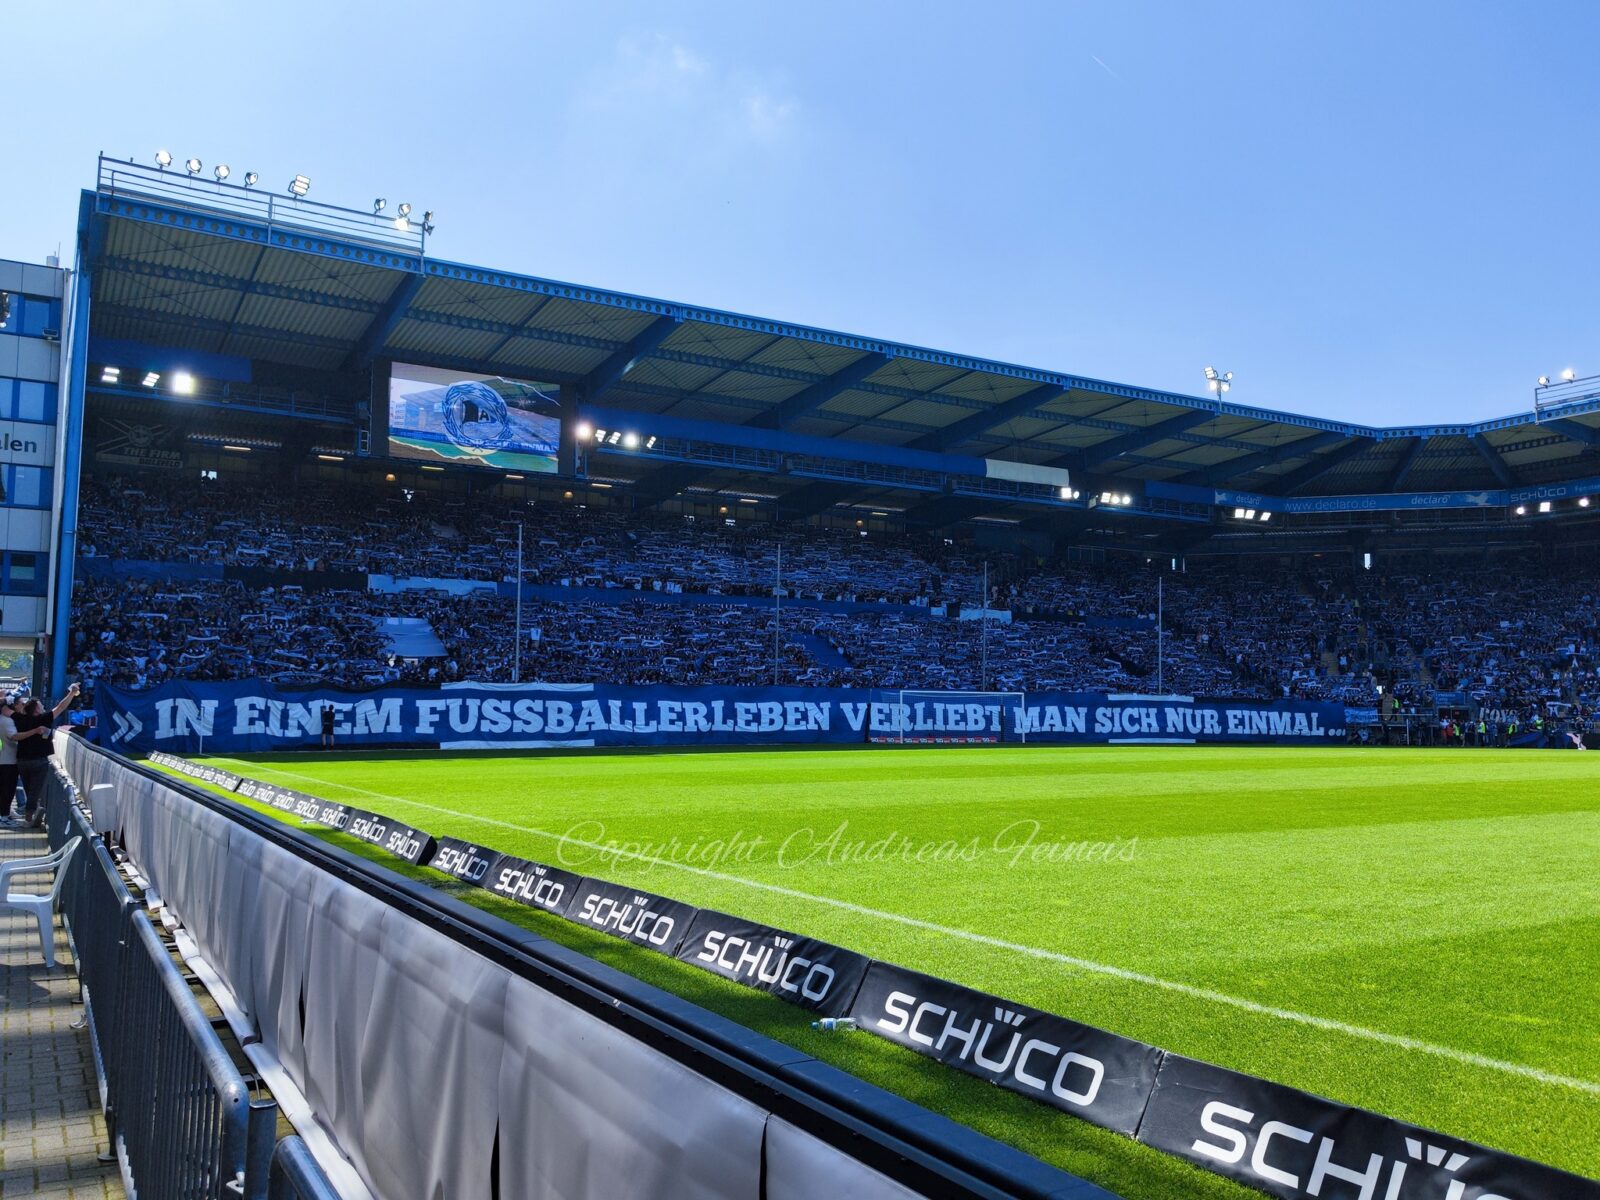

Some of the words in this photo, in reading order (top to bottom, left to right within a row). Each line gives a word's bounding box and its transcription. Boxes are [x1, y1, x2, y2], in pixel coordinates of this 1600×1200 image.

[0, 433, 37, 453] len
[123, 447, 148, 458] THE
[149, 449, 182, 461] FIRM
[1285, 497, 1376, 511] www.declaro.de
[1411, 495, 1449, 505] declaro
[1511, 487, 1566, 502] SCHÜCO
[155, 698, 218, 739] IN
[233, 696, 402, 738] EINEM
[415, 698, 831, 735] FUSSBALLERLEBEN
[840, 702, 1001, 732] VERLIEBT
[1013, 706, 1087, 734] MAN
[1095, 707, 1160, 734] SICH
[1164, 708, 1222, 734] NUR
[319, 806, 349, 828] SCHÜCO
[350, 816, 386, 842] SCHÜCO
[386, 830, 421, 860] SCHÜCO
[435, 847, 489, 881] SCHÜCO
[494, 867, 565, 908] SCHÜCO
[578, 896, 675, 946] SCHÜCO
[697, 930, 835, 1001] SCHÜCO
[877, 991, 1105, 1106] SCHÜCO
